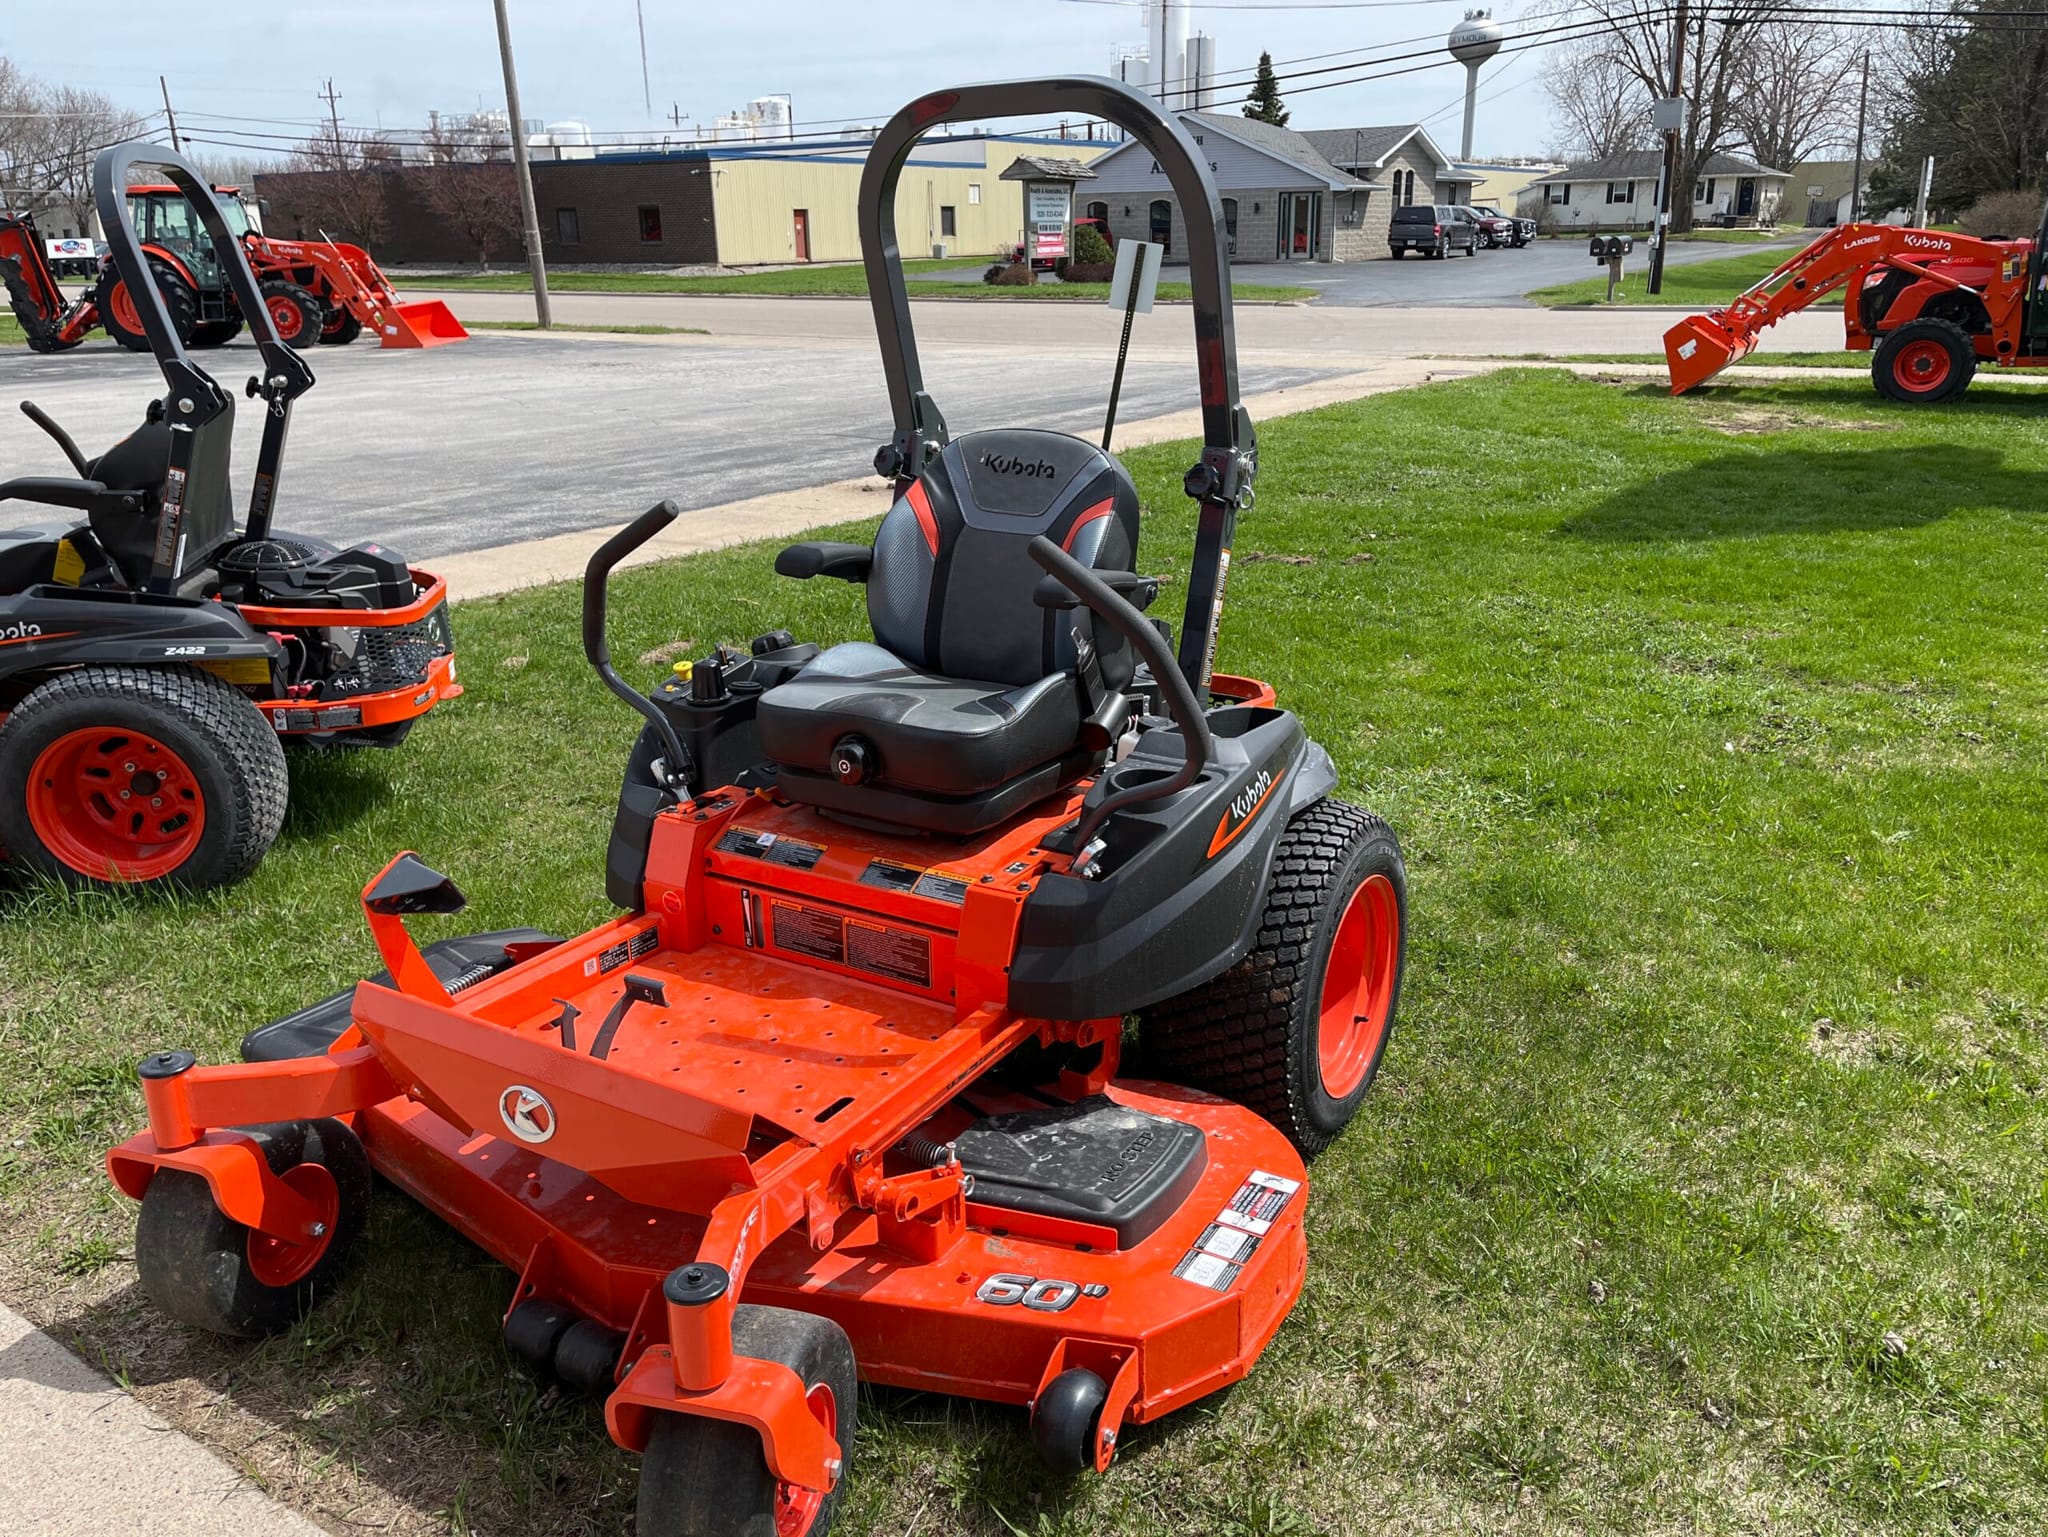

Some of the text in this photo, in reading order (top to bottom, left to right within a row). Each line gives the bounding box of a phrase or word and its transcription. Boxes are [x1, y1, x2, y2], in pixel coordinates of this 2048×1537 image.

[1844, 234, 1881, 250] LA1065
[1904, 234, 1951, 251] Kubota
[985, 453, 1056, 479] Kubota
[164, 646, 206, 656] Z422
[1230, 770, 1272, 819] Kubota
[1101, 1129, 1155, 1183] NO STEP
[976, 1272, 1110, 1313] 60"
